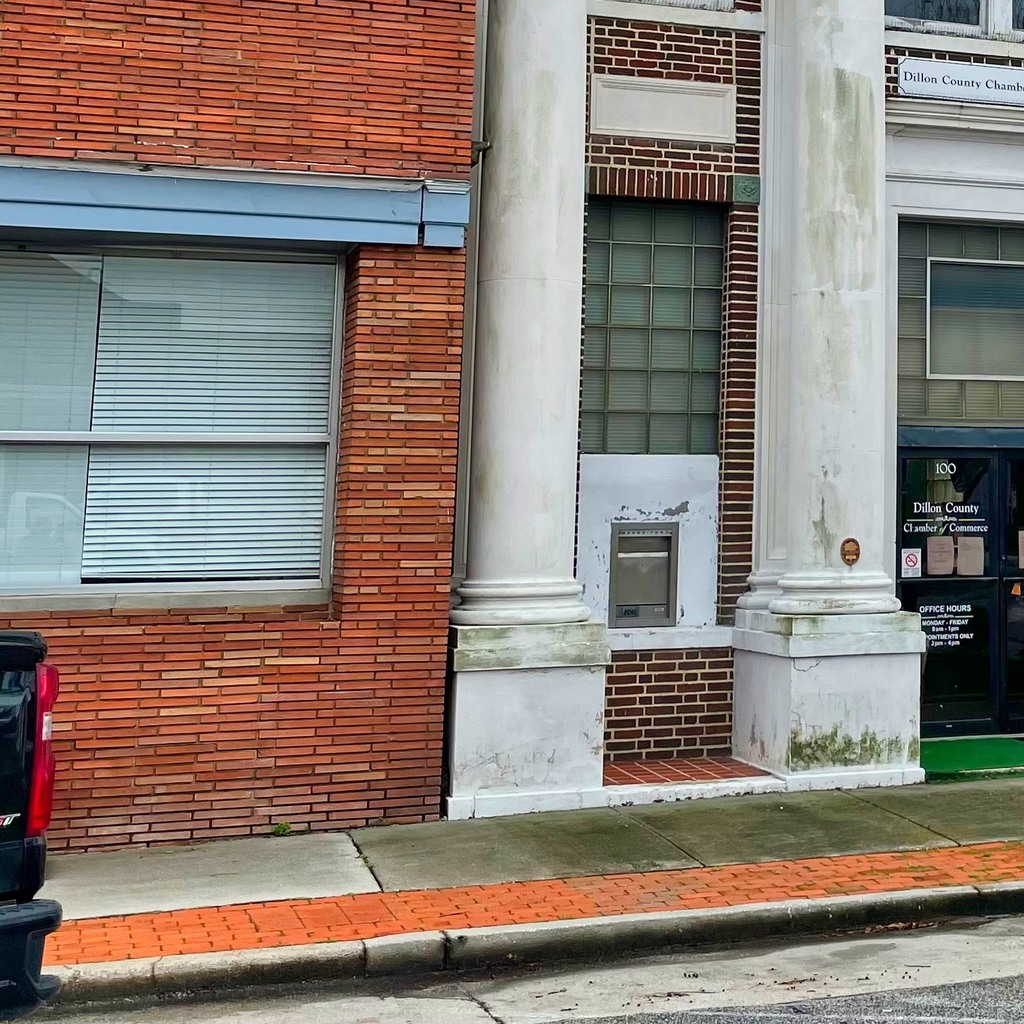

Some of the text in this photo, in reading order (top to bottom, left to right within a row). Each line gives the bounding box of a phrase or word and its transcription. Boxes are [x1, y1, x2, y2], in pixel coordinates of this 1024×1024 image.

[903, 71, 938, 84] Dillon
[942, 75, 982, 89] County
[935, 462, 957, 474] 100
[913, 502, 979, 515] Dillon County
[939, 523, 949, 535] of
[949, 522, 989, 532] Commerce
